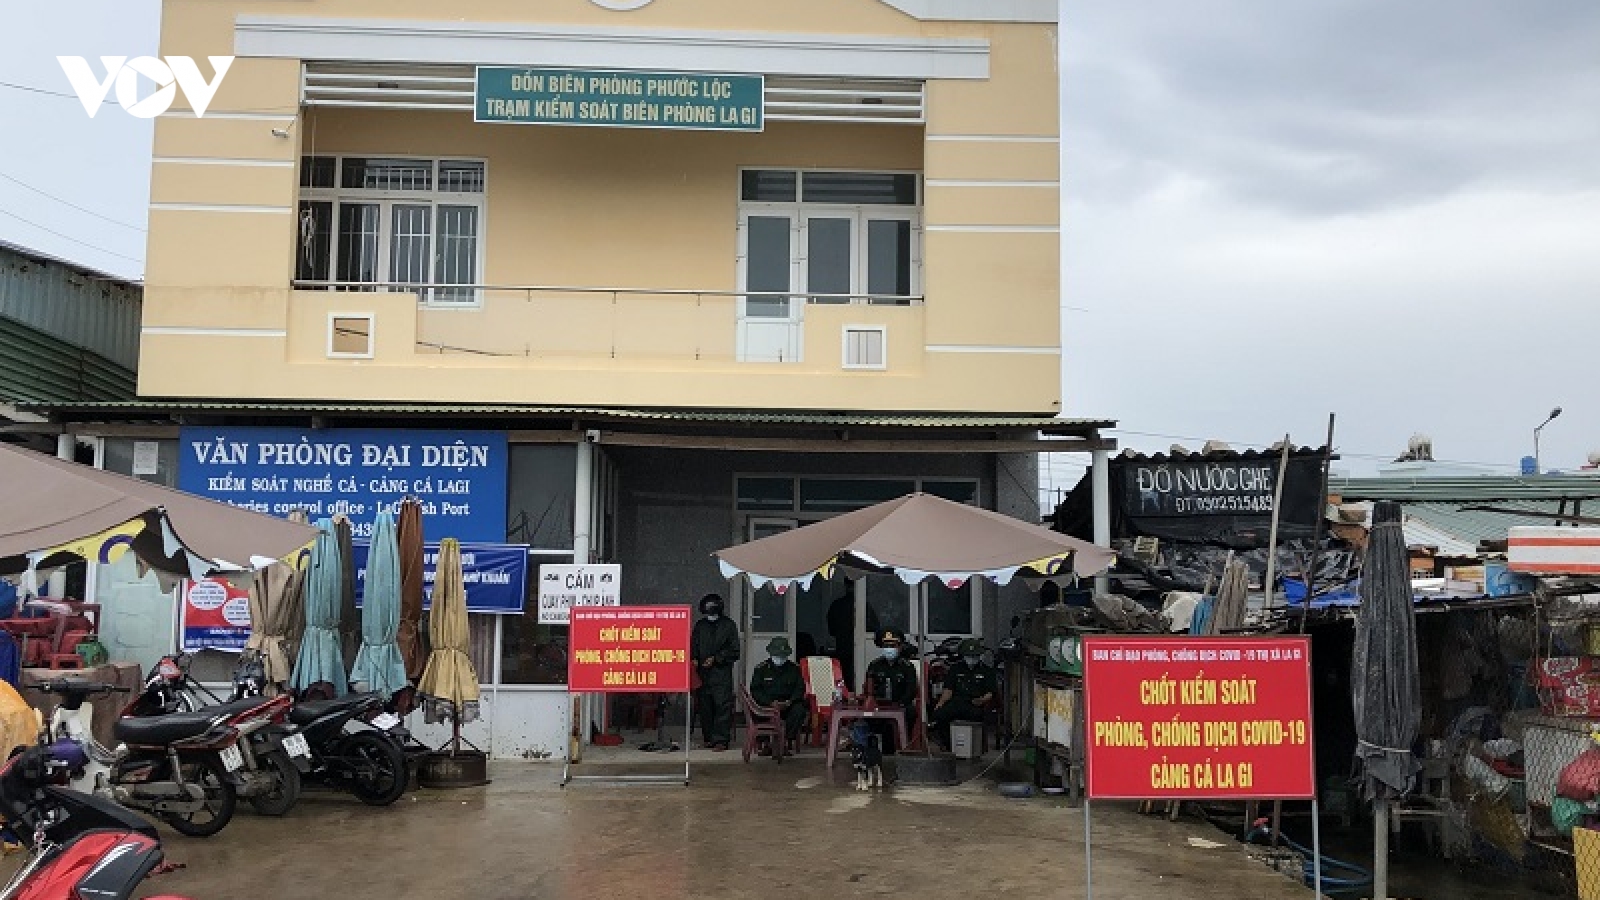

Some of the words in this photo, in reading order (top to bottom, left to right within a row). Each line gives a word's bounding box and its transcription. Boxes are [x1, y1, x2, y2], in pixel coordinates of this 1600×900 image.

[549, 73, 585, 94] BIÊN
[589, 74, 642, 96] PHÒNG
[647, 76, 699, 98] PHƯỚC
[703, 78, 732, 101] LỘC
[485, 97, 531, 120] TRẠM
[534, 94, 575, 119] KIỂM
[579, 100, 618, 119] SOÁT
[623, 100, 659, 121] BIÊN
[663, 101, 715, 123] PHÒNG
[192, 436, 249, 465] VĂN
[257, 436, 352, 465] PHÒNG
[361, 444, 411, 472] ĐẠI
[421, 439, 489, 472] DIỆN
[208, 471, 246, 491] KIỂM
[251, 475, 288, 491] SOÁT
[293, 472, 333, 492] NGHỀ
[369, 476, 409, 494] CẢNG
[413, 475, 433, 493] CÁ
[437, 479, 471, 494] LAGI
[1239, 467, 1272, 491] GHE
[327, 500, 364, 514] office
[442, 501, 471, 515] Port
[565, 567, 595, 589] CẤM
[1140, 671, 1177, 705] CHỐT
[1180, 670, 1217, 705] KIỂM
[1220, 674, 1257, 705] SOÁT
[1095, 715, 1148, 750] PHÒNG,
[1151, 712, 1200, 747] CHỐNG
[1203, 720, 1238, 753] DỊCH
[1241, 719, 1305, 746] COVID-19
[1151, 755, 1191, 789] CẢNG
[1193, 757, 1213, 789] CÁ
[1217, 763, 1235, 789] LA
[1237, 762, 1253, 789] GI
